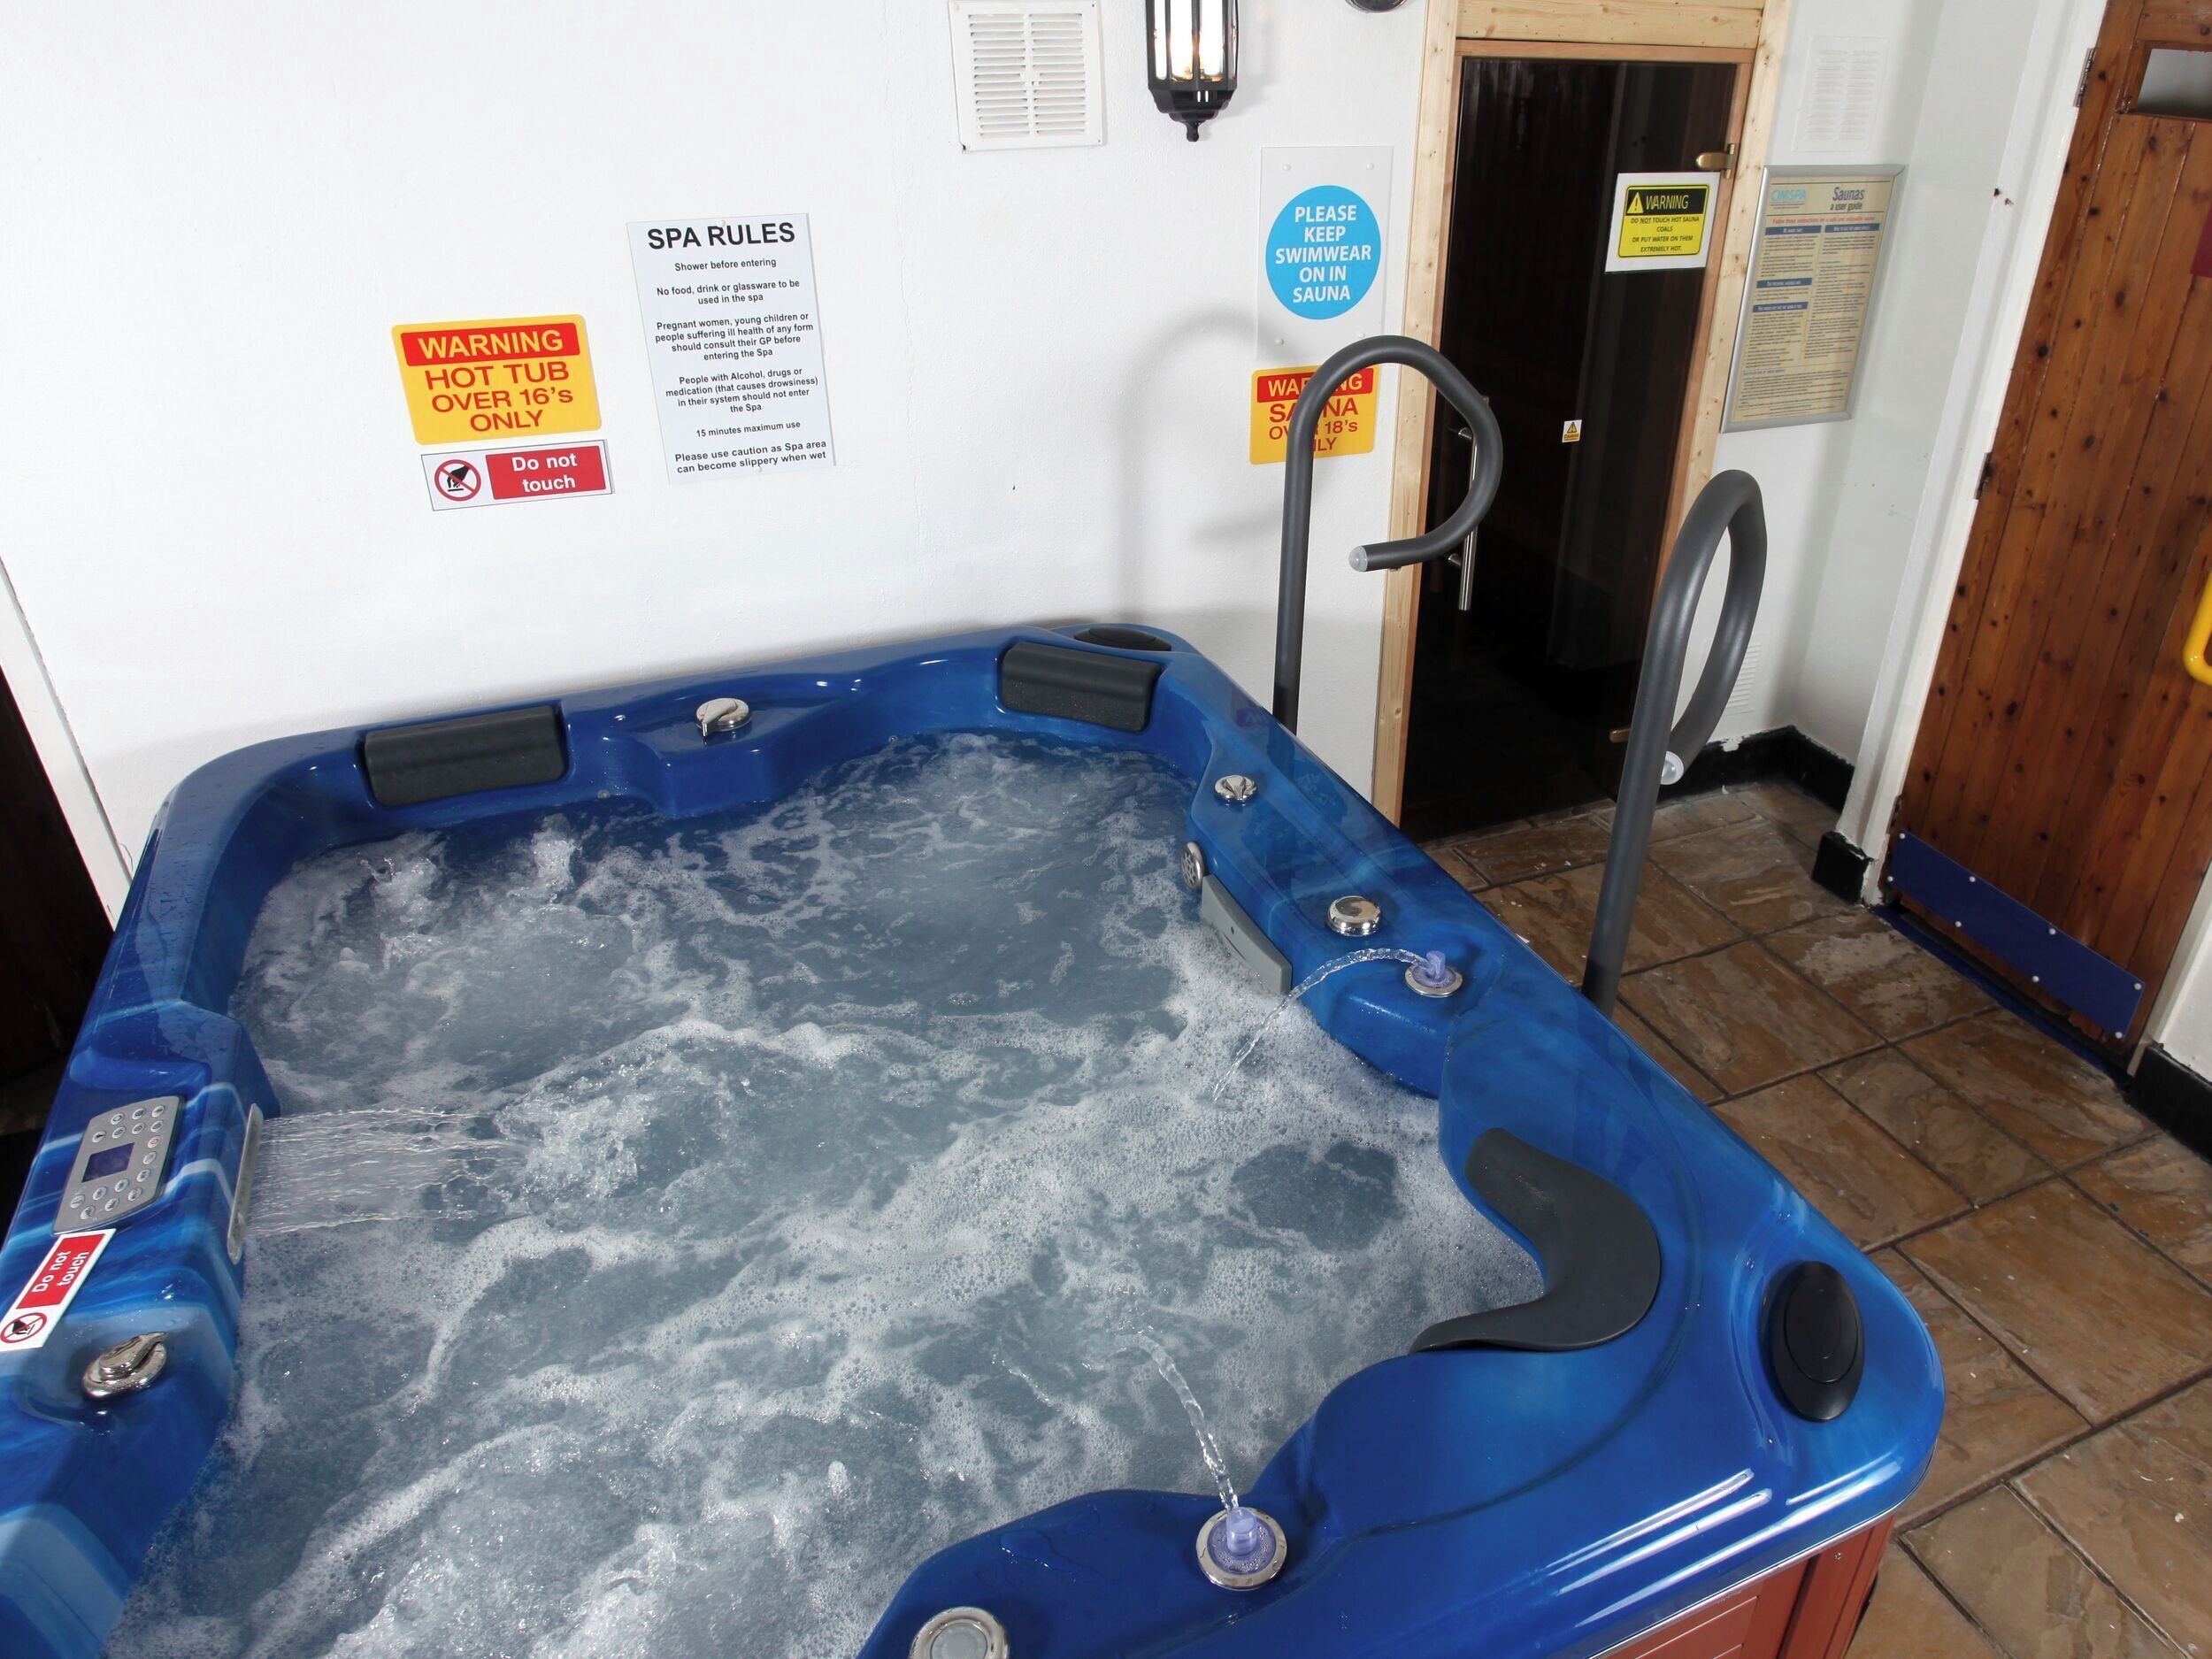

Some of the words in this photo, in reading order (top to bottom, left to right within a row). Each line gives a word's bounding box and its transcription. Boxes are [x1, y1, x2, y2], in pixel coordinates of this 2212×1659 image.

[1647, 195, 1688, 210] WARNING
[1833, 187, 1865, 201] Saunas
[1295, 205, 1356, 222] PLEASE
[1847, 203, 1863, 211] guide
[648, 227, 702, 250] SPA
[707, 223, 795, 246] RULES
[1304, 226, 1346, 242] KEEP
[1276, 245, 1371, 264] SWIMWEAR
[675, 263, 708, 272] Shower
[710, 260, 738, 269] before
[741, 258, 776, 267] entering
[1300, 266, 1326, 282] ON
[1330, 265, 1346, 280] IN
[672, 286, 695, 295] food,
[697, 284, 719, 293] drink
[733, 282, 776, 293] glassware
[1294, 286, 1350, 303] SAUNA
[698, 296, 719, 304] used
[732, 294, 745, 303] the
[657, 320, 696, 331] Pregnant
[734, 317, 761, 326] young
[764, 313, 797, 322] children
[655, 333, 684, 344] people
[687, 329, 726, 340] suffering
[737, 326, 764, 335] health
[418, 330, 564, 359] WARNING
[672, 342, 701, 352] should
[703, 340, 736, 349] consult
[737, 338, 757, 347] their
[703, 351, 739, 360] entering
[757, 349, 773, 357] Spa
[425, 366, 494, 389] HOT
[503, 362, 569, 383] TUB
[680, 375, 709, 385] People
[731, 370, 765, 380] Alcohol,
[665, 387, 712, 396] medication
[715, 384, 734, 394] (that
[768, 376, 818, 388] drowsiness)
[432, 390, 511, 412] OVER
[688, 397, 708, 406] their
[710, 396, 740, 405] system
[742, 391, 771, 401] should
[746, 403, 762, 412] Spa
[471, 411, 543, 432] ONLY
[709, 427, 741, 436] minutes
[744, 424, 784, 433] maximum
[675, 453, 708, 462] Please
[732, 447, 768, 456] caution
[785, 443, 803, 452] Spa
[512, 457, 539, 471] Do
[547, 454, 578, 468] not
[697, 462, 736, 471] become
[523, 475, 575, 492] touch
[33, 1275, 54, 1292] Do
[50, 1251, 71, 1271] not
[58, 1252, 89, 1286] touch
